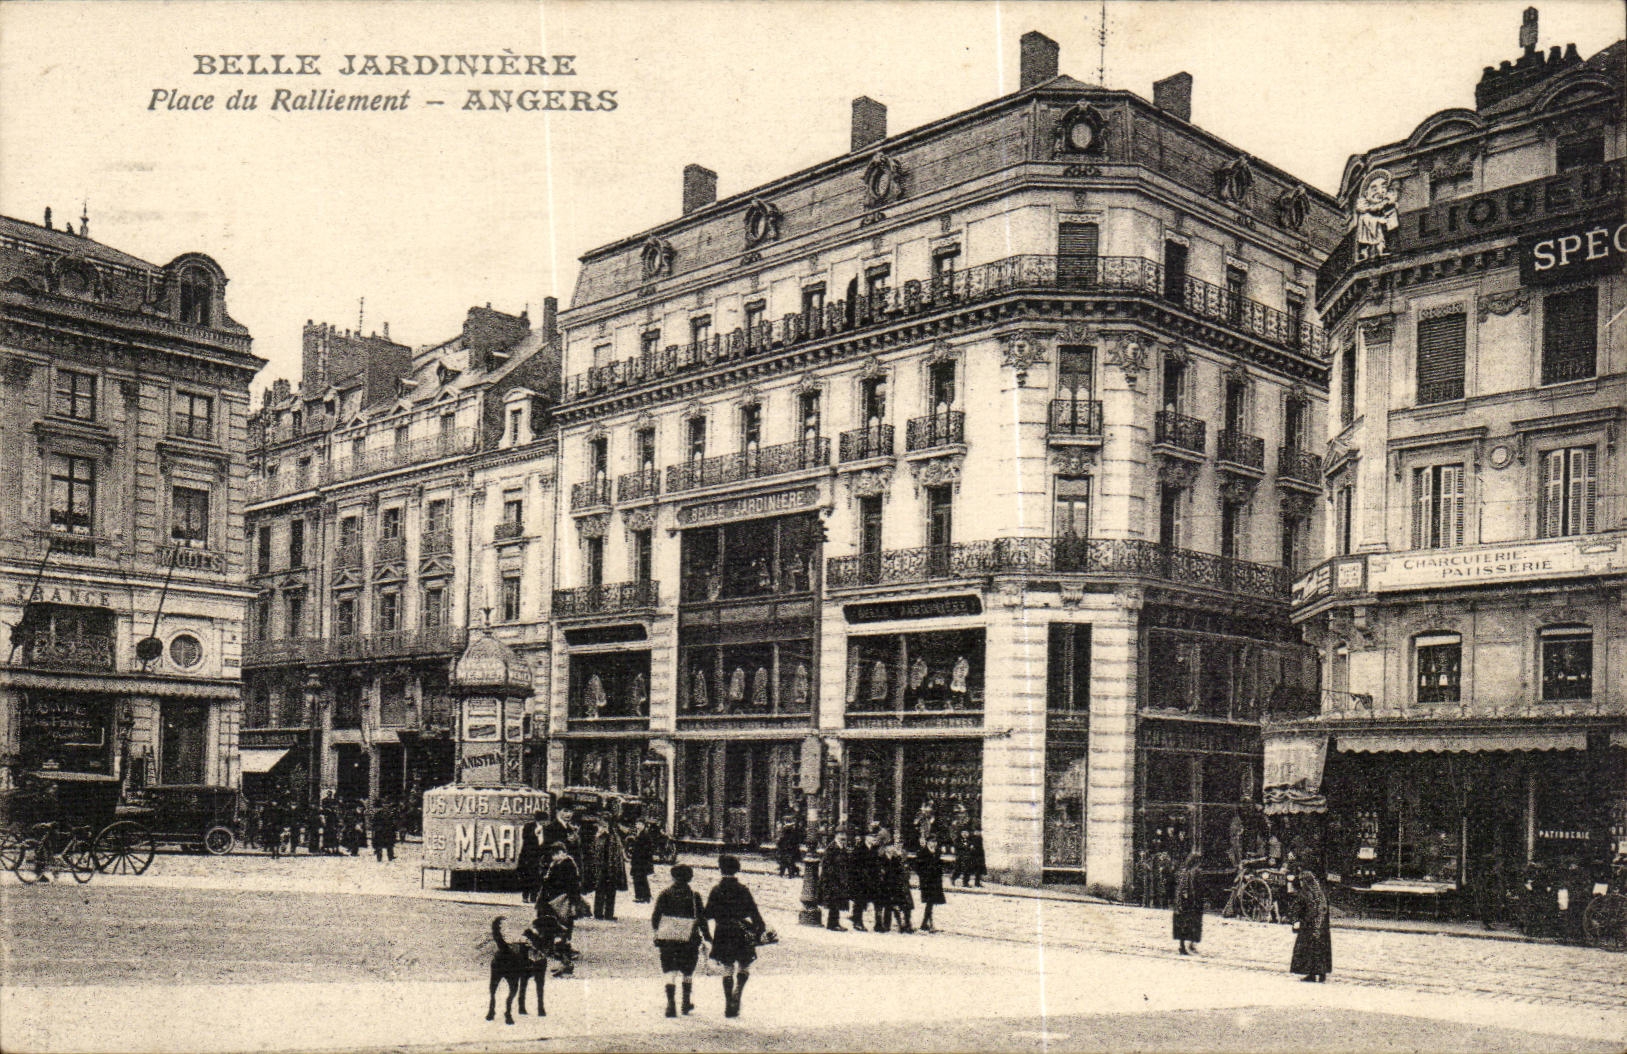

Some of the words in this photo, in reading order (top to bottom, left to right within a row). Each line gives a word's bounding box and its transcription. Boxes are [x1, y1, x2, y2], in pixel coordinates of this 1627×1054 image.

[691, 504, 726, 522] BELLE
[455, 795, 489, 814] VOS
[455, 824, 523, 862] MAR
